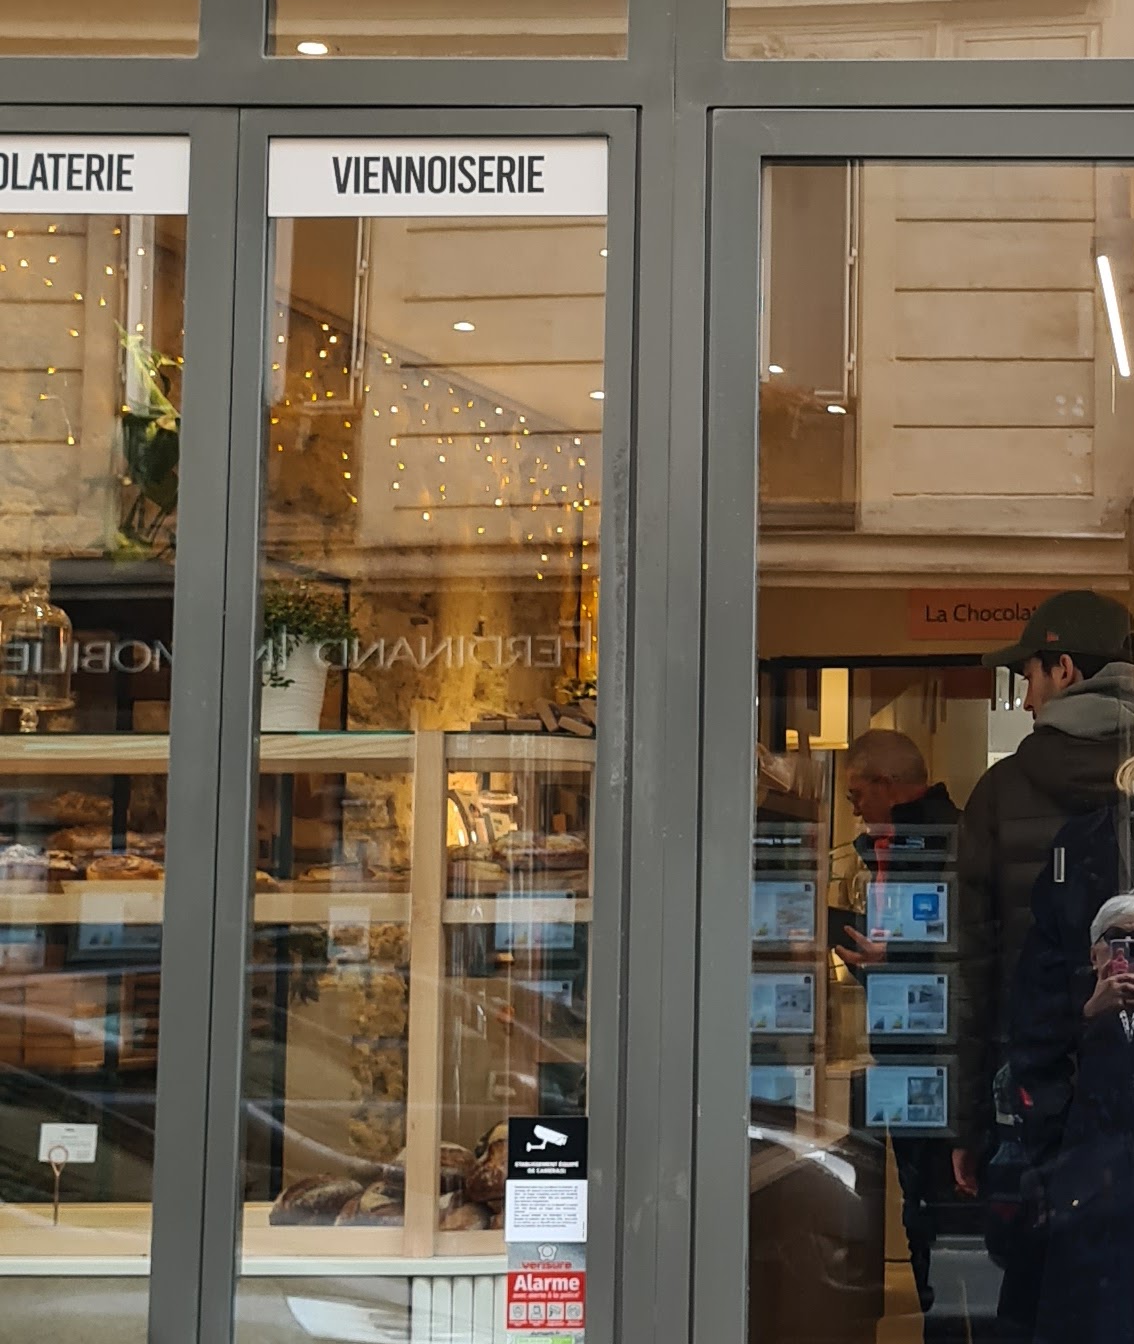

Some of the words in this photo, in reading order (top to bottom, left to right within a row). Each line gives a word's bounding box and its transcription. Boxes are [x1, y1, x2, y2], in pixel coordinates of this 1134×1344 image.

[332, 155, 546, 194] VIENNOISERIE
[925, 605, 948, 623] La
[953, 602, 1037, 623] Chocola
[521, 1261, 572, 1269] verisure
[514, 1273, 580, 1292] Alarme
